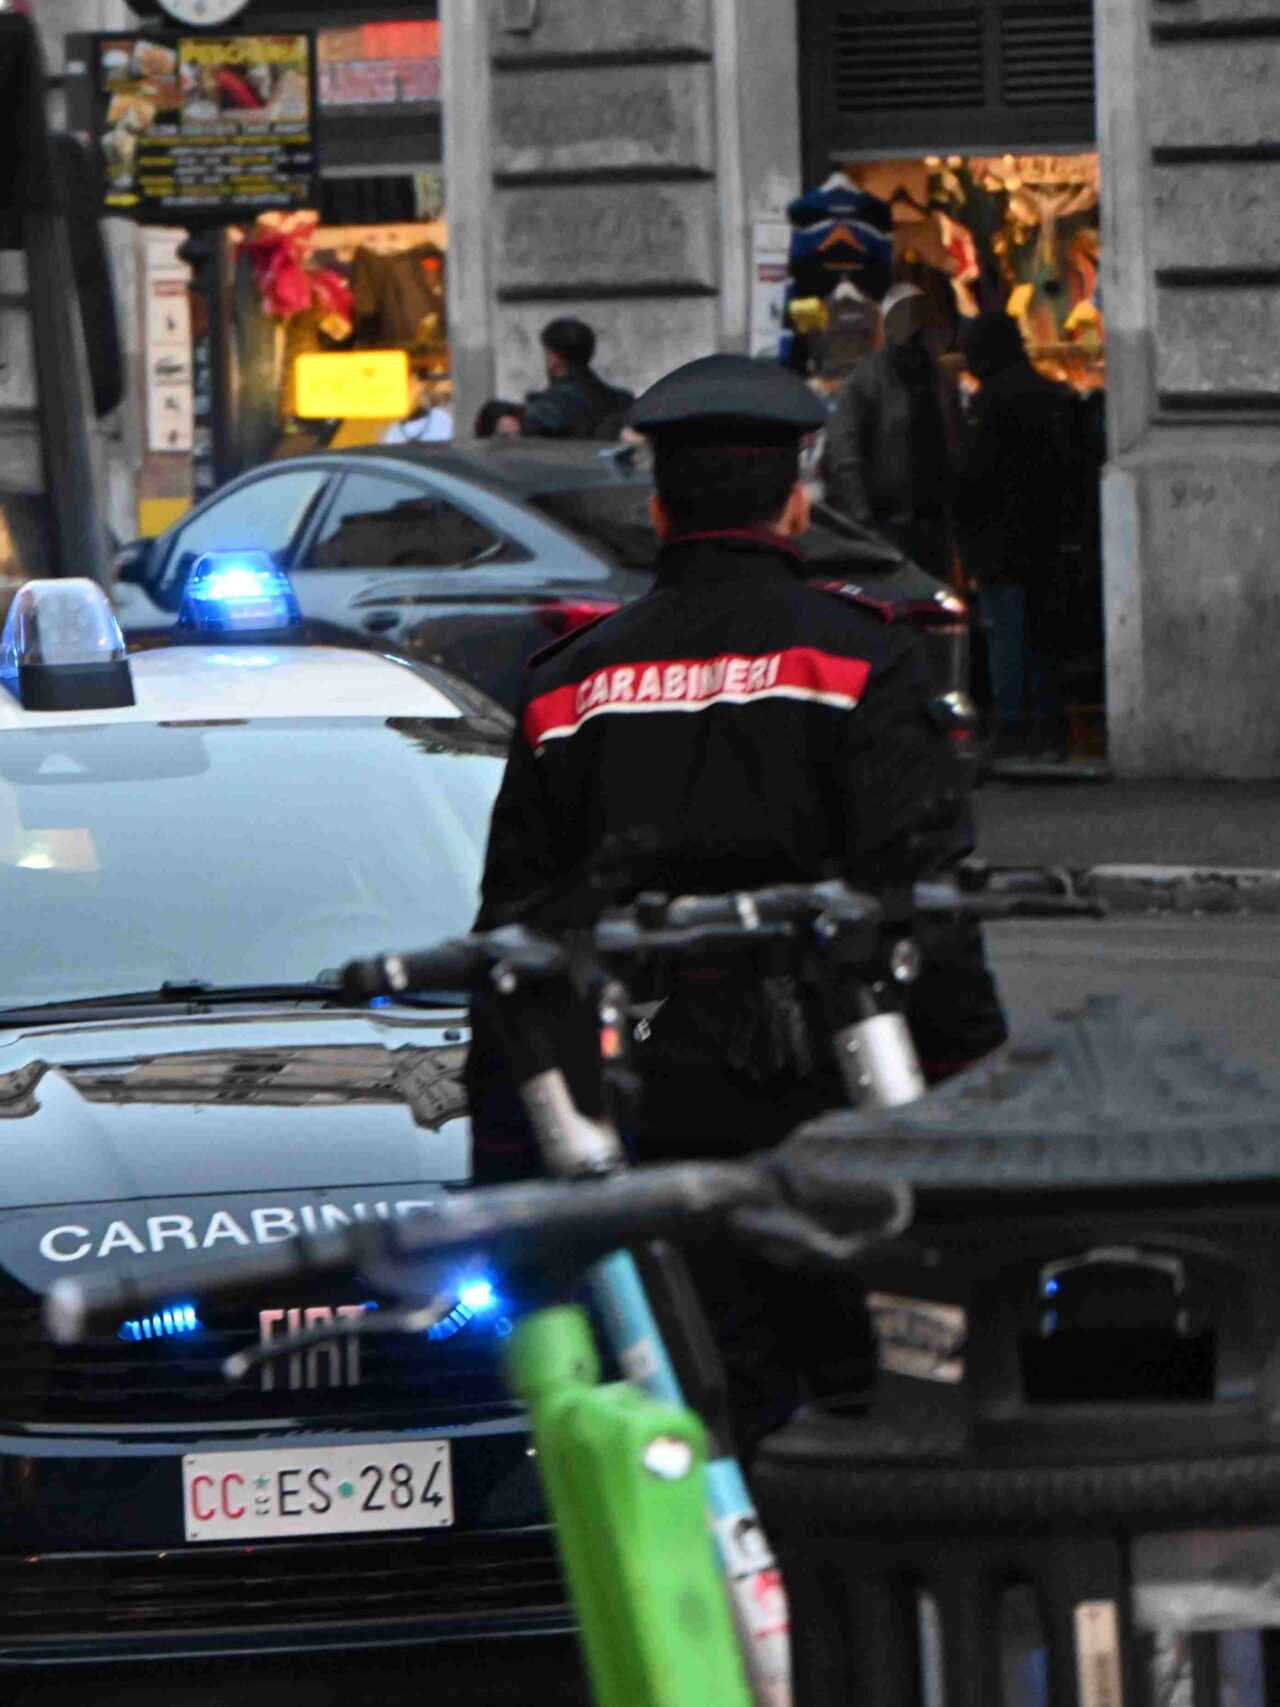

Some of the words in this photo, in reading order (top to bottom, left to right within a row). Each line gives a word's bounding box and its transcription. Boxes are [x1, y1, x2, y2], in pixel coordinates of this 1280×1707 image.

[575, 654, 782, 715] CARABINIERI
[259, 1305, 366, 1392] FIAT
[360, 1459, 445, 1513] 284
